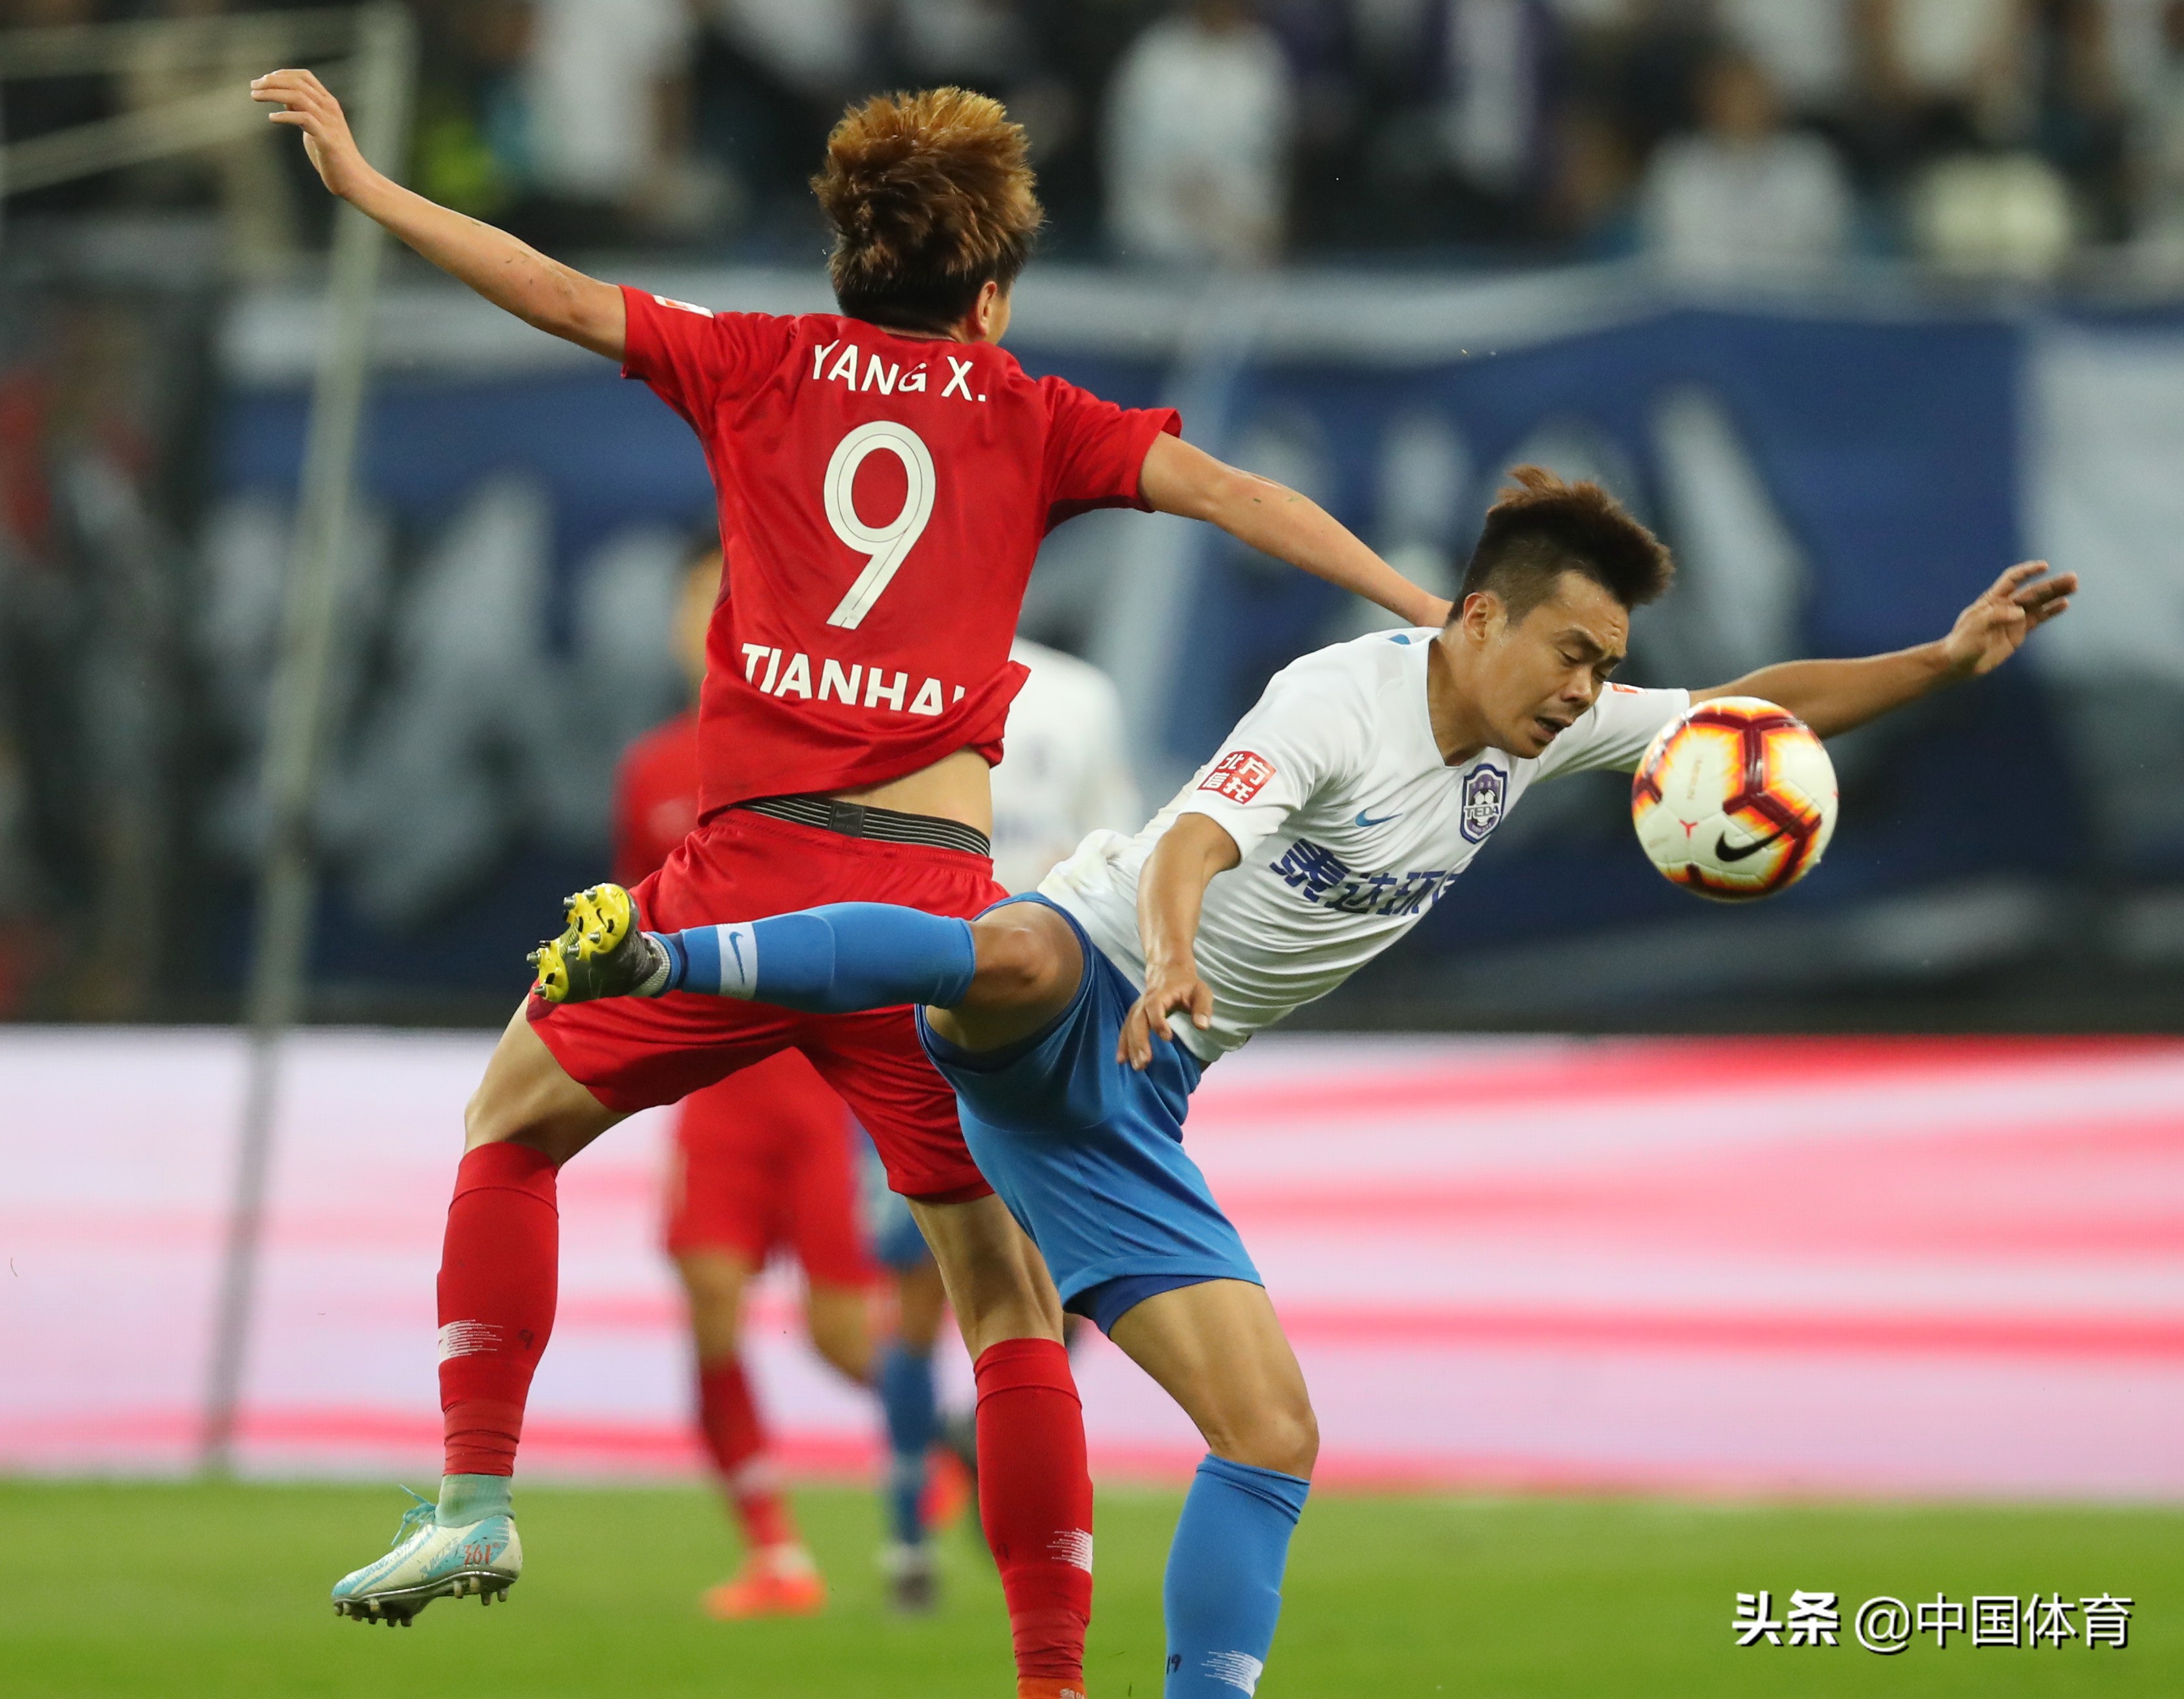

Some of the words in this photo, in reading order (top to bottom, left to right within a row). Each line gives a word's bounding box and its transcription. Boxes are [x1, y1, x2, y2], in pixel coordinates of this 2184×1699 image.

[812, 339, 927, 396] YANG
[940, 356, 987, 403] X.
[824, 420, 936, 631] 9
[1218, 754, 1271, 786] 北方
[1201, 771, 1254, 802] 信托
[1463, 805, 1500, 819] TEDA
